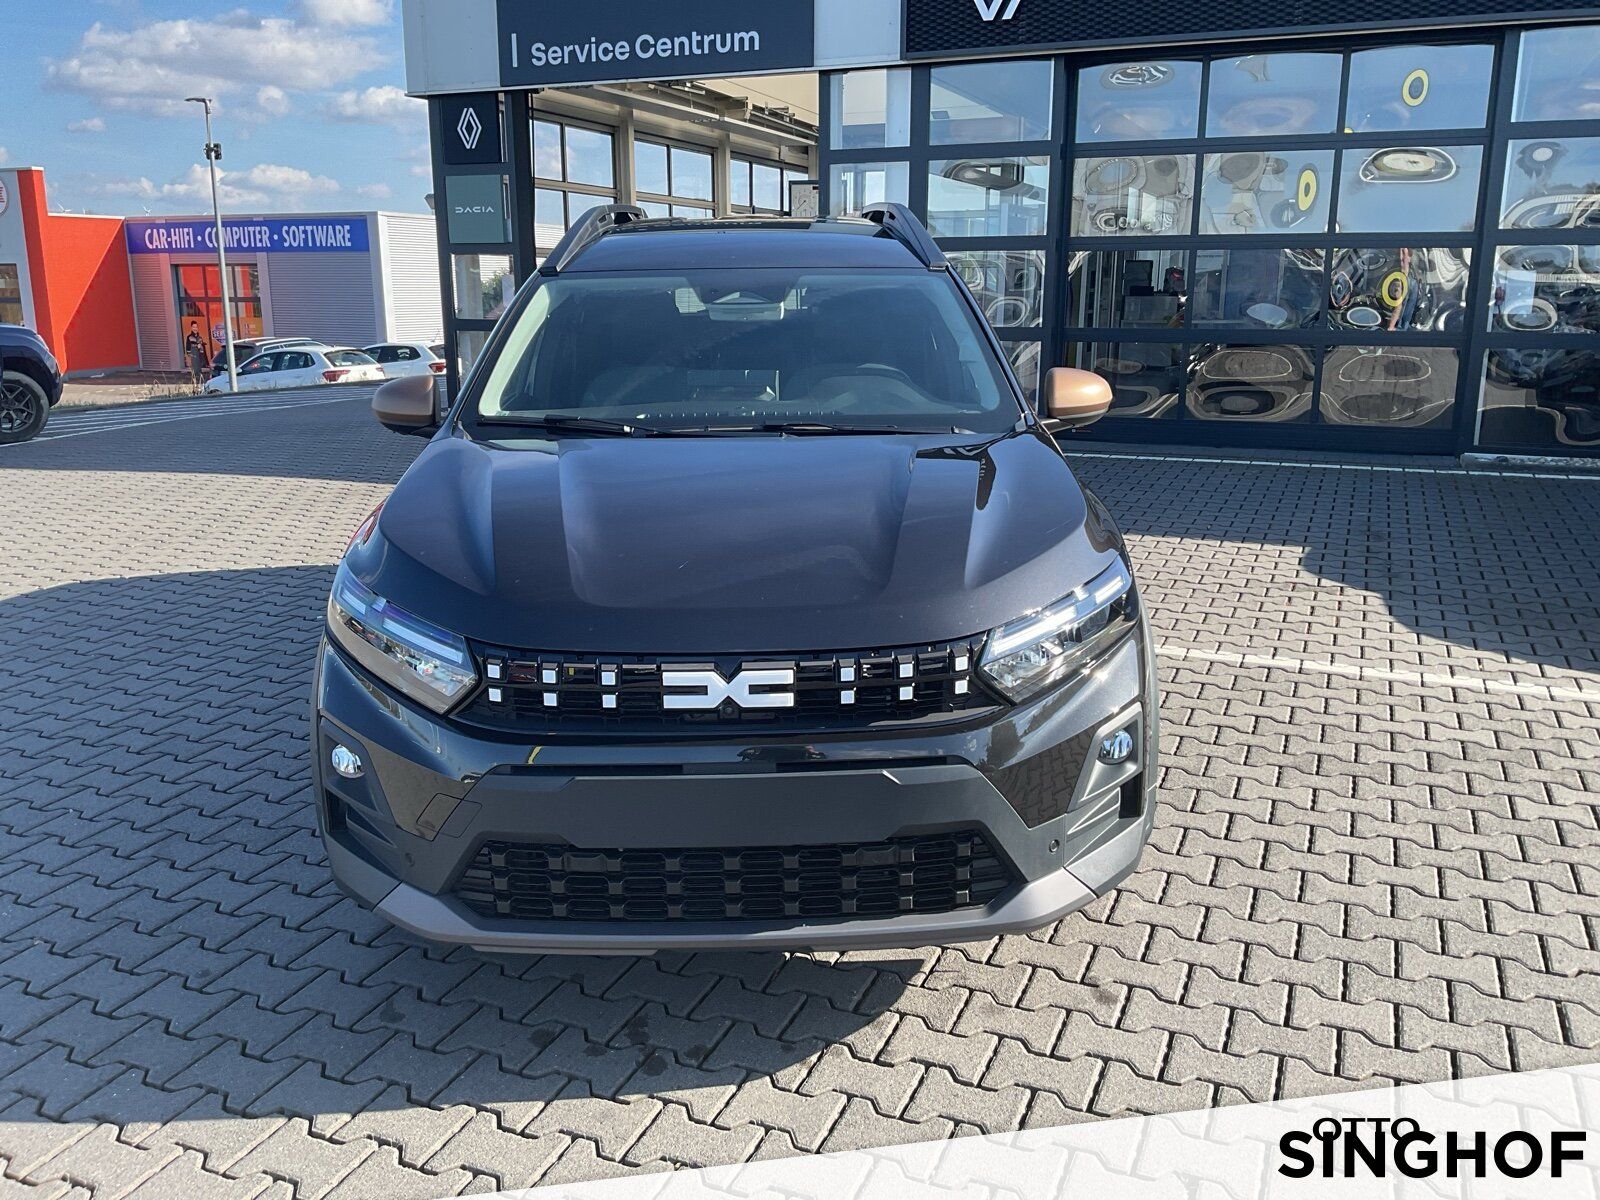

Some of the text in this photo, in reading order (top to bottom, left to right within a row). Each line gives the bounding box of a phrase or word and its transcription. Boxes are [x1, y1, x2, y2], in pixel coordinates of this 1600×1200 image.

[531, 30, 760, 66] Service Centrum
[454, 206, 495, 214] DACIA
[144, 226, 195, 249] CAR-HIFI
[283, 225, 352, 247] SOFTWARE
